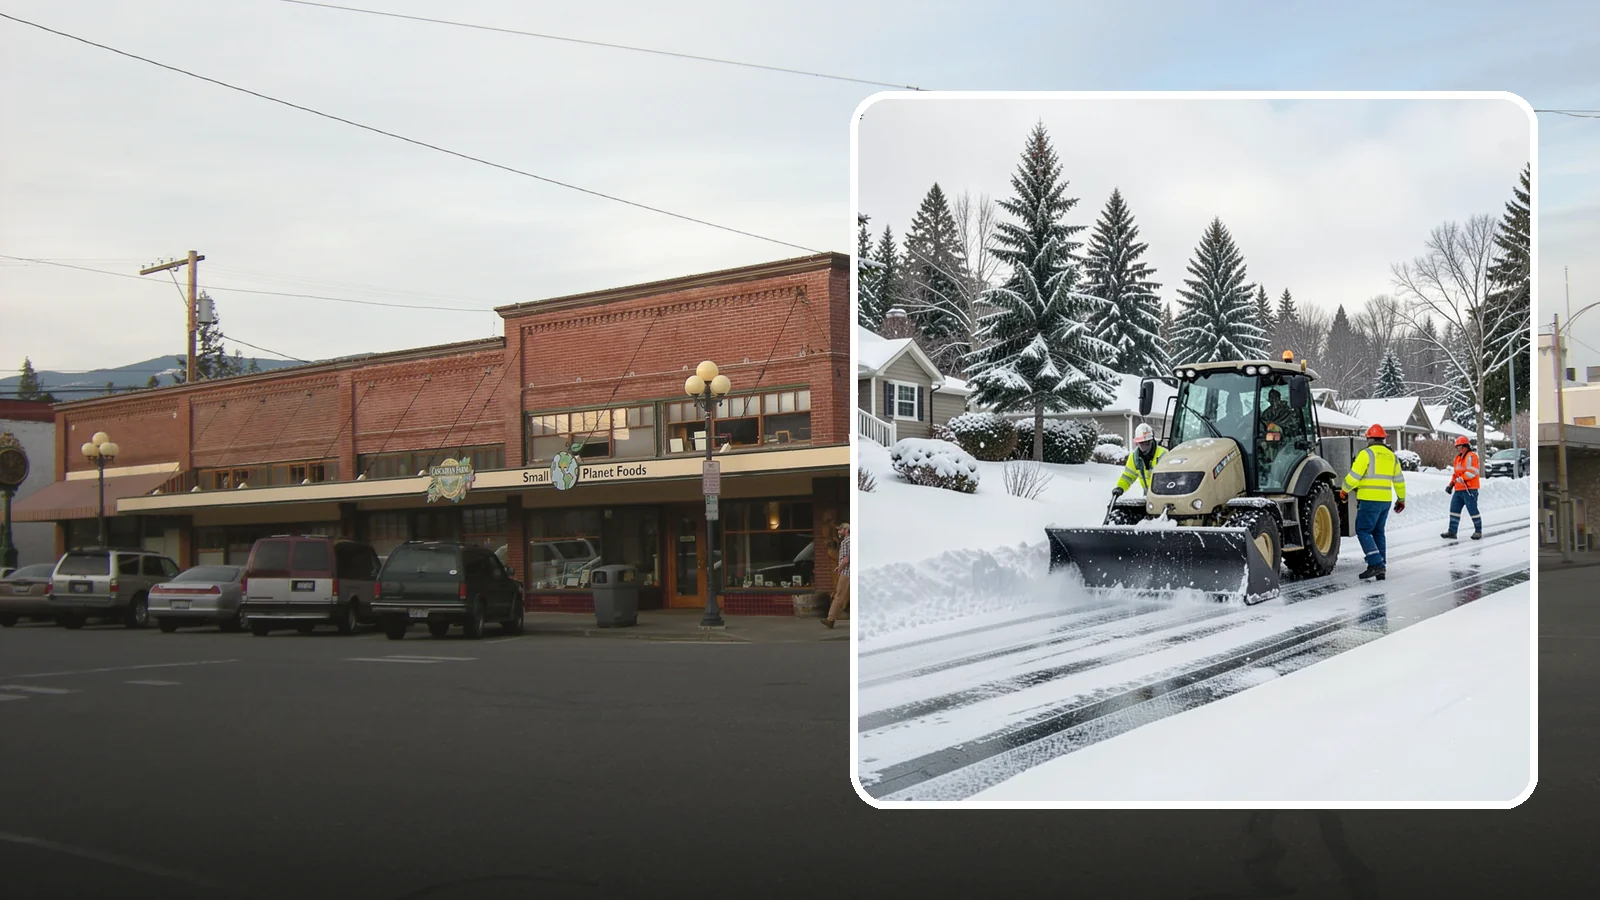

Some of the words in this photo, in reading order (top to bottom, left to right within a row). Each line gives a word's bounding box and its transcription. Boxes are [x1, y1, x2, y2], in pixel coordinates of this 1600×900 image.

[523, 470, 549, 483] Small
[583, 467, 614, 479] Planet
[616, 464, 647, 477] Foods
